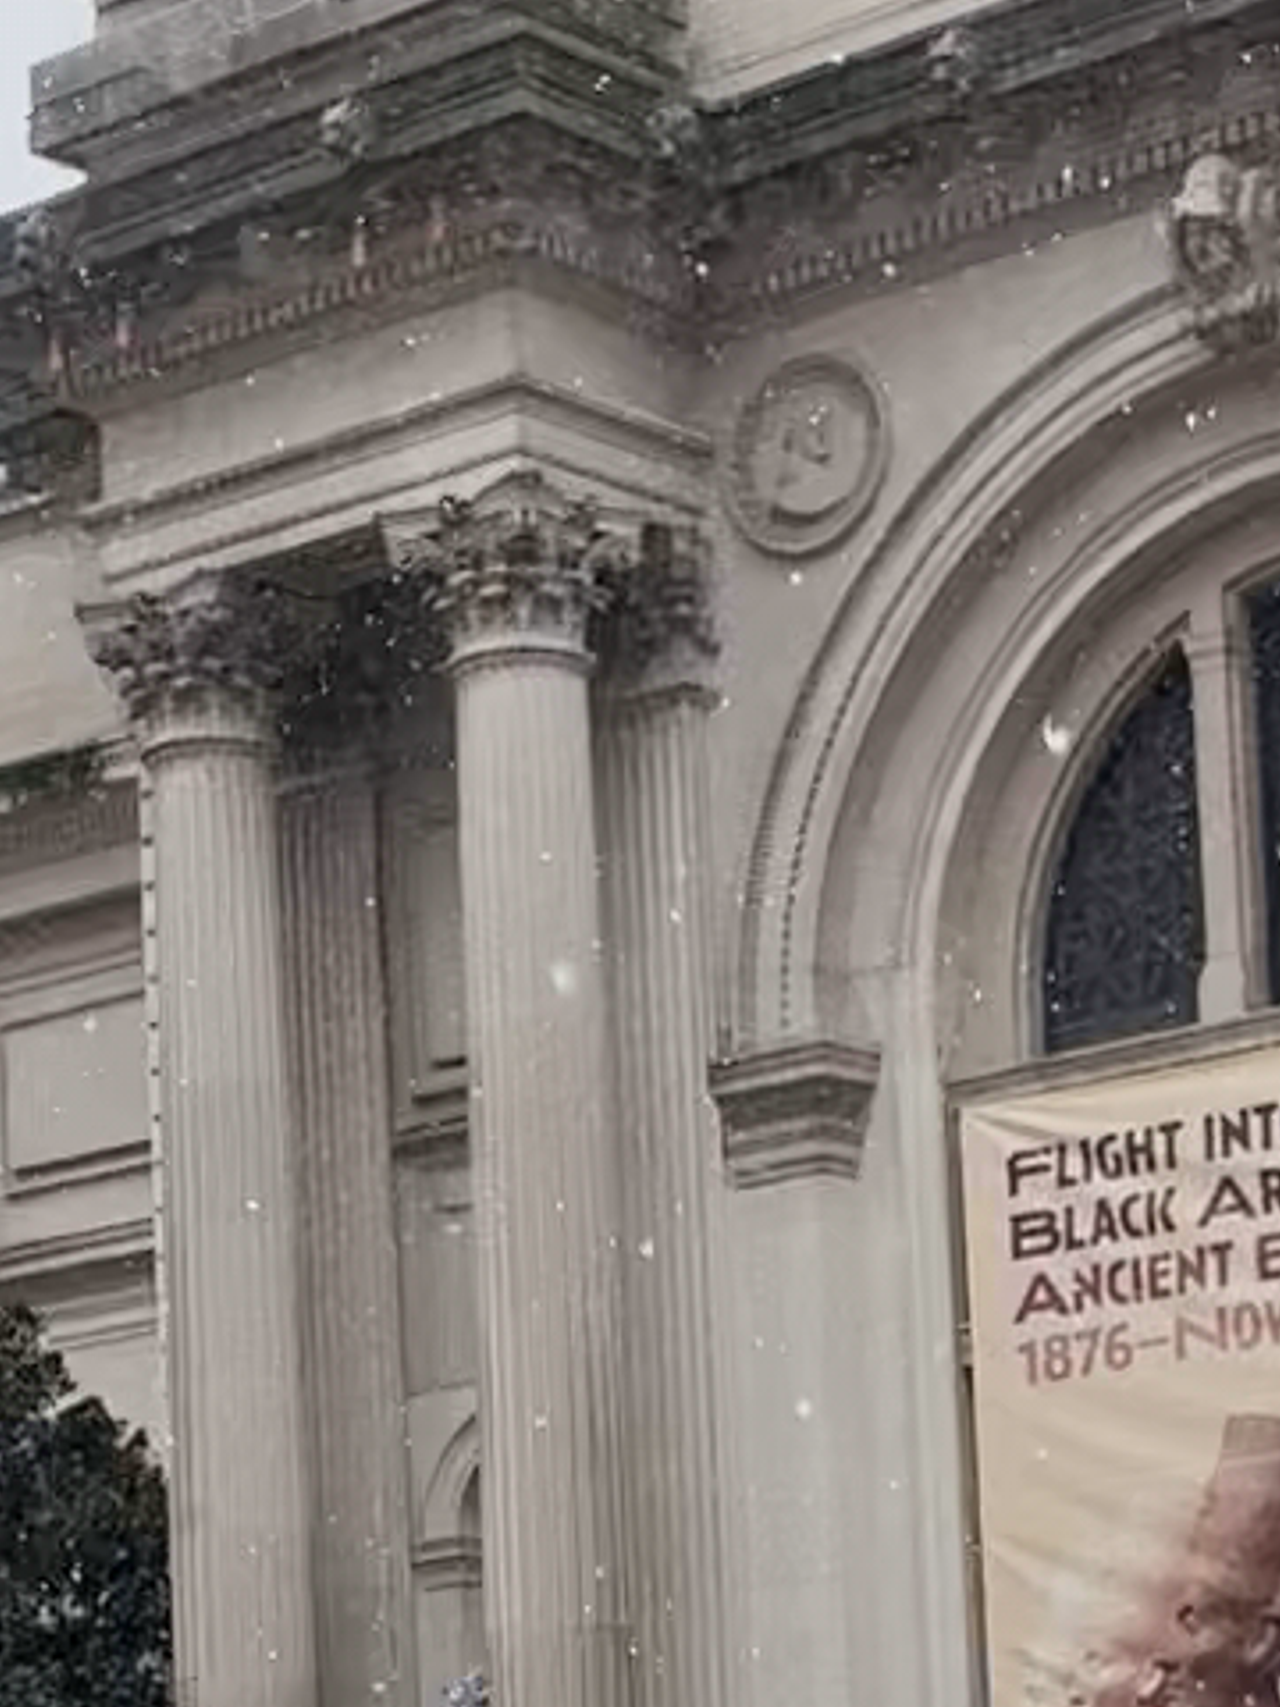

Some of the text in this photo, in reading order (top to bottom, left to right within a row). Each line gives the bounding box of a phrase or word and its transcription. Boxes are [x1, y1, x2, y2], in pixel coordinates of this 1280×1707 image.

[1007, 1121, 1183, 1197] FLIGHT
[1010, 1186, 1176, 1260] BLACK
[1015, 1241, 1233, 1324] ANCIENT
